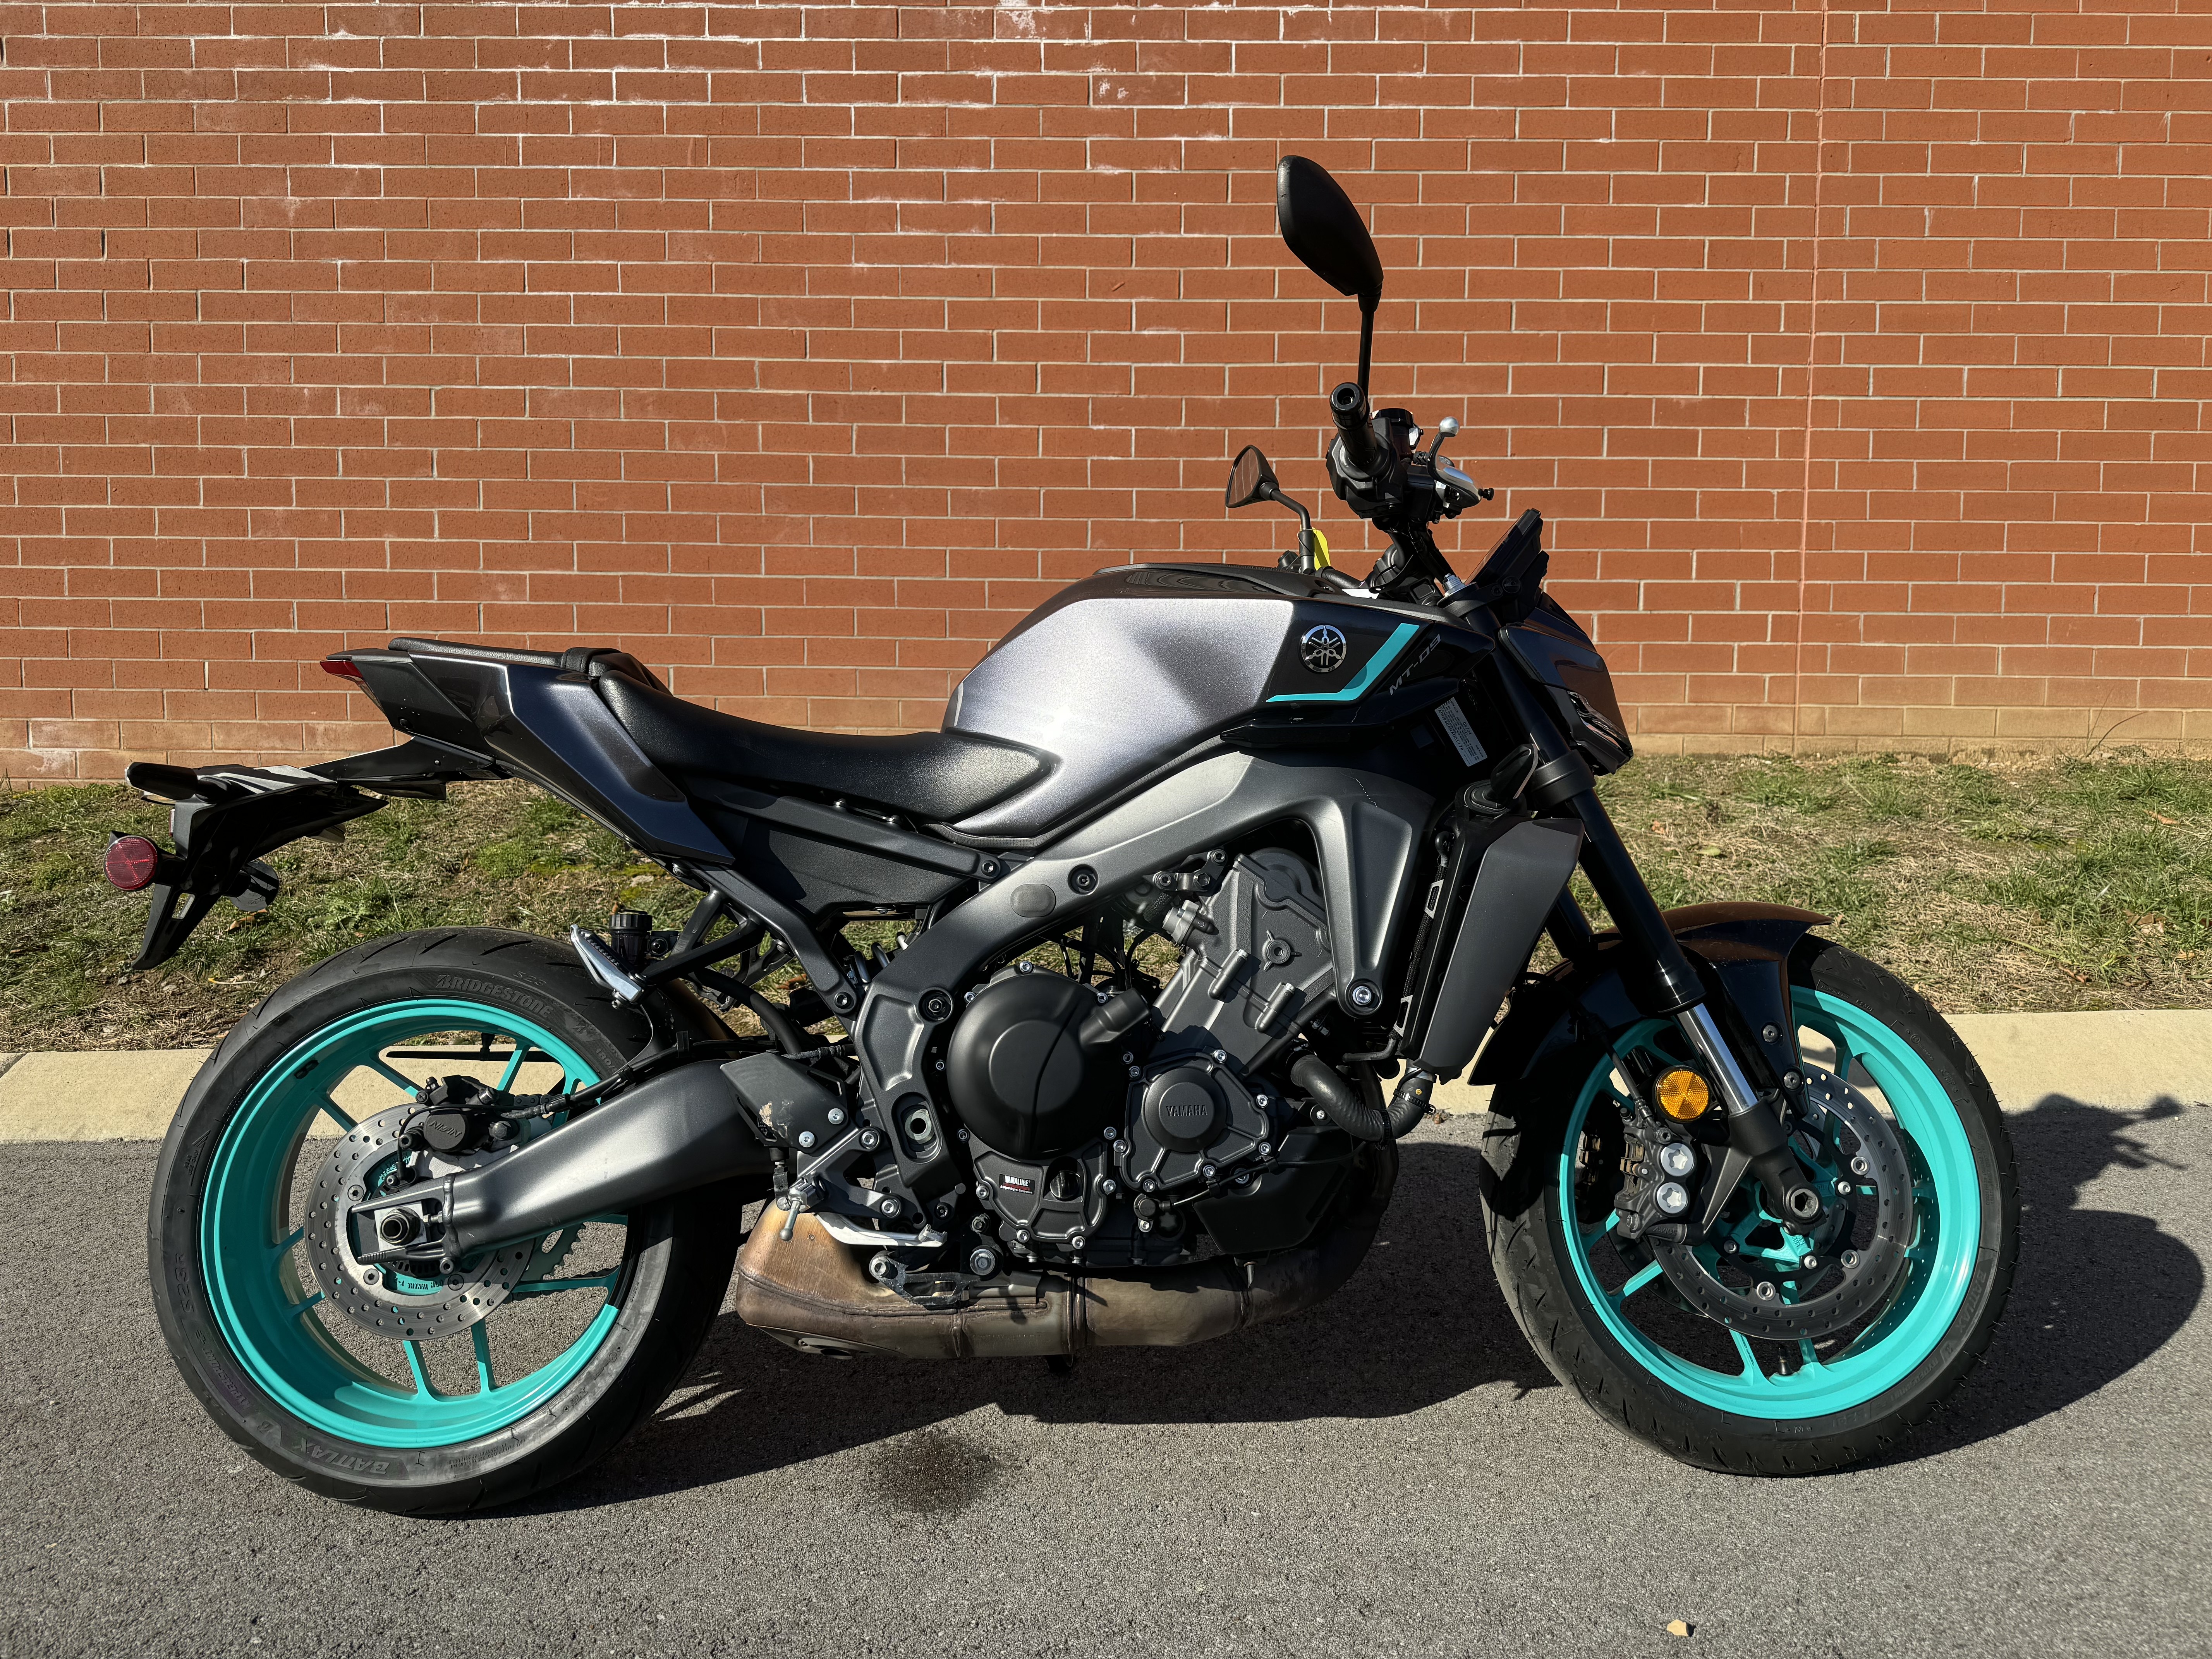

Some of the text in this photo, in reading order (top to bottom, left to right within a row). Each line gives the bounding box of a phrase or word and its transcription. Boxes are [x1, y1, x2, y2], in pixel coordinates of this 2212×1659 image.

[1389, 634, 1441, 696] MT-09
[436, 974, 554, 1018] BRIDGESTONE
[513, 971, 546, 986] S23
[1166, 1105, 1207, 1117] YAMAHA
[175, 1253, 194, 1313] S23R
[1959, 1270, 1987, 1333] BATTLAX
[205, 1349, 252, 1413] HYPERSPORT
[292, 1437, 390, 1475] BATTLAX
